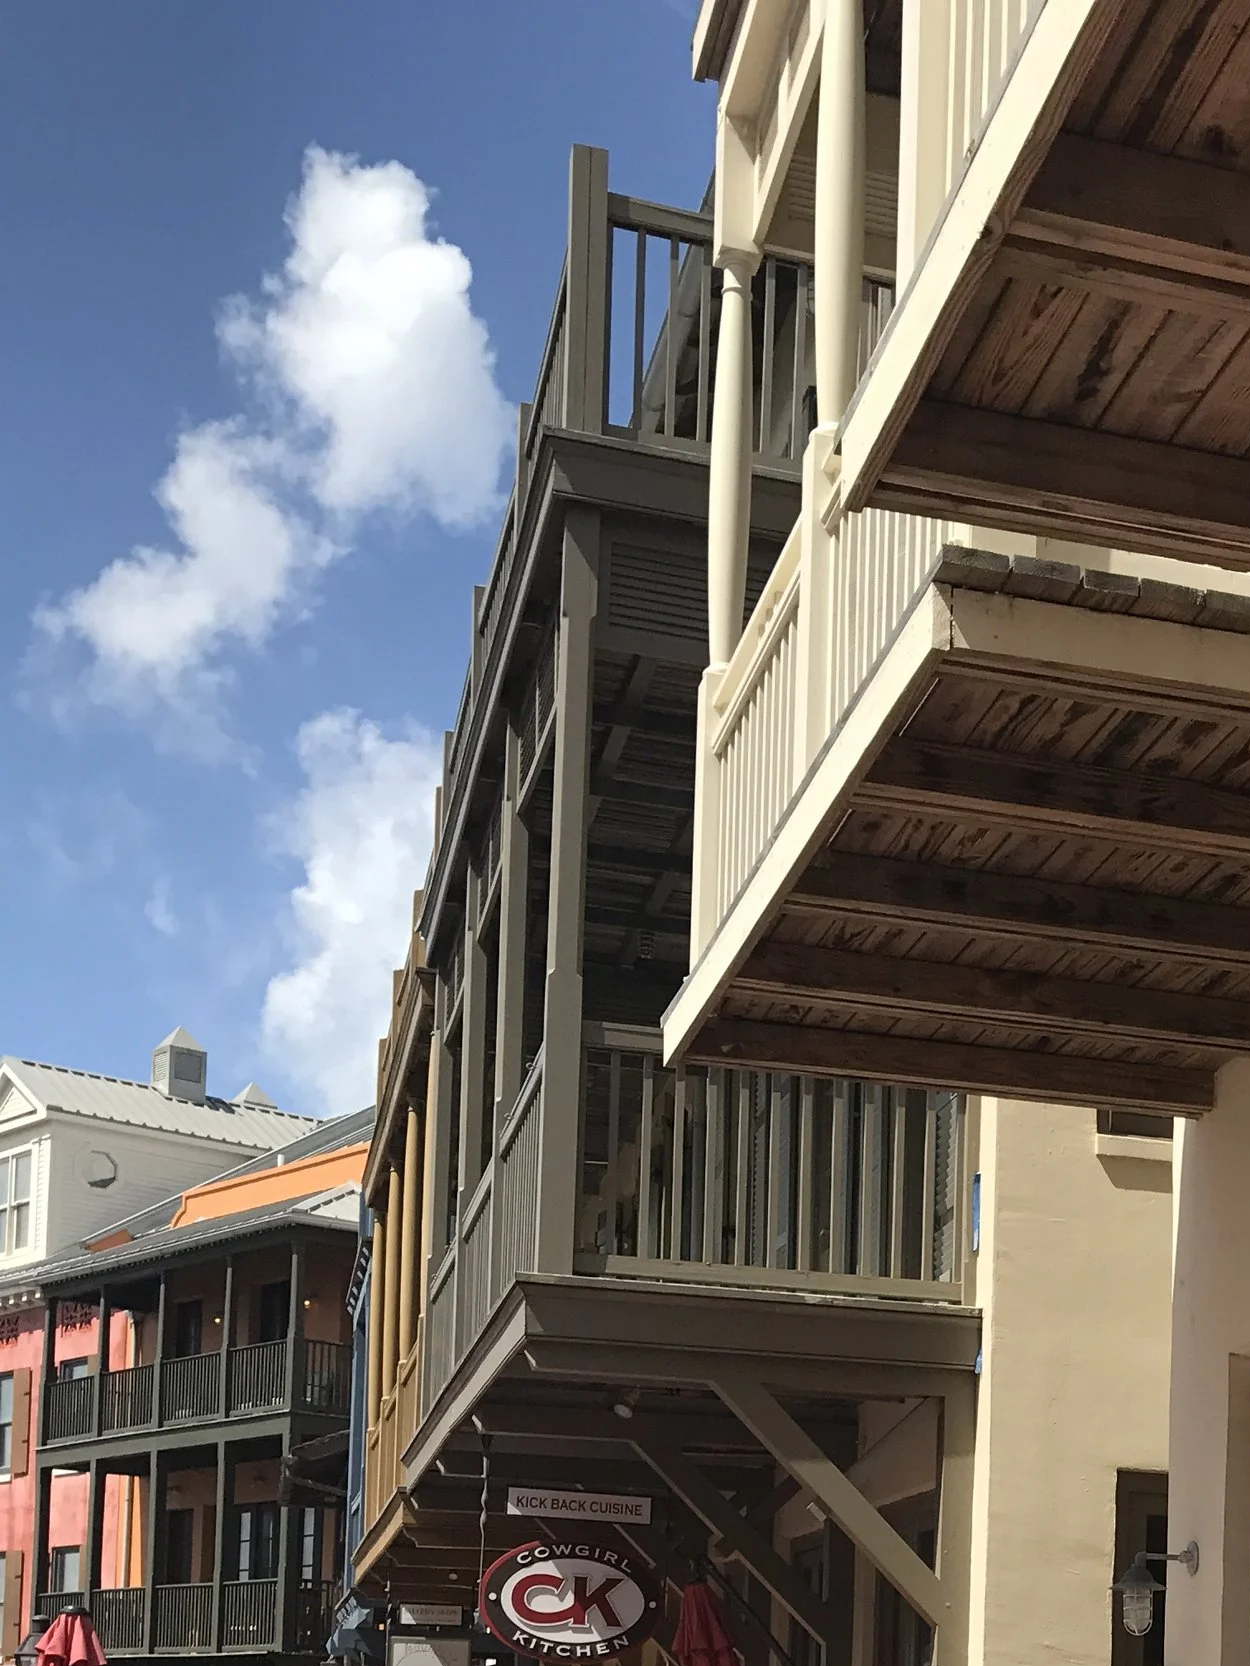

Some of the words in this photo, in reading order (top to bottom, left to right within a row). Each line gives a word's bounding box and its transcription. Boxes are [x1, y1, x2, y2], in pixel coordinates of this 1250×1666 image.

[516, 1495, 548, 1510] KICK
[550, 1498, 588, 1513] BACK
[589, 1501, 643, 1517] CUISINE
[516, 1544, 632, 1573] COWGIRL
[511, 1573, 625, 1629] CK
[512, 1630, 630, 1657] KITCHEN
